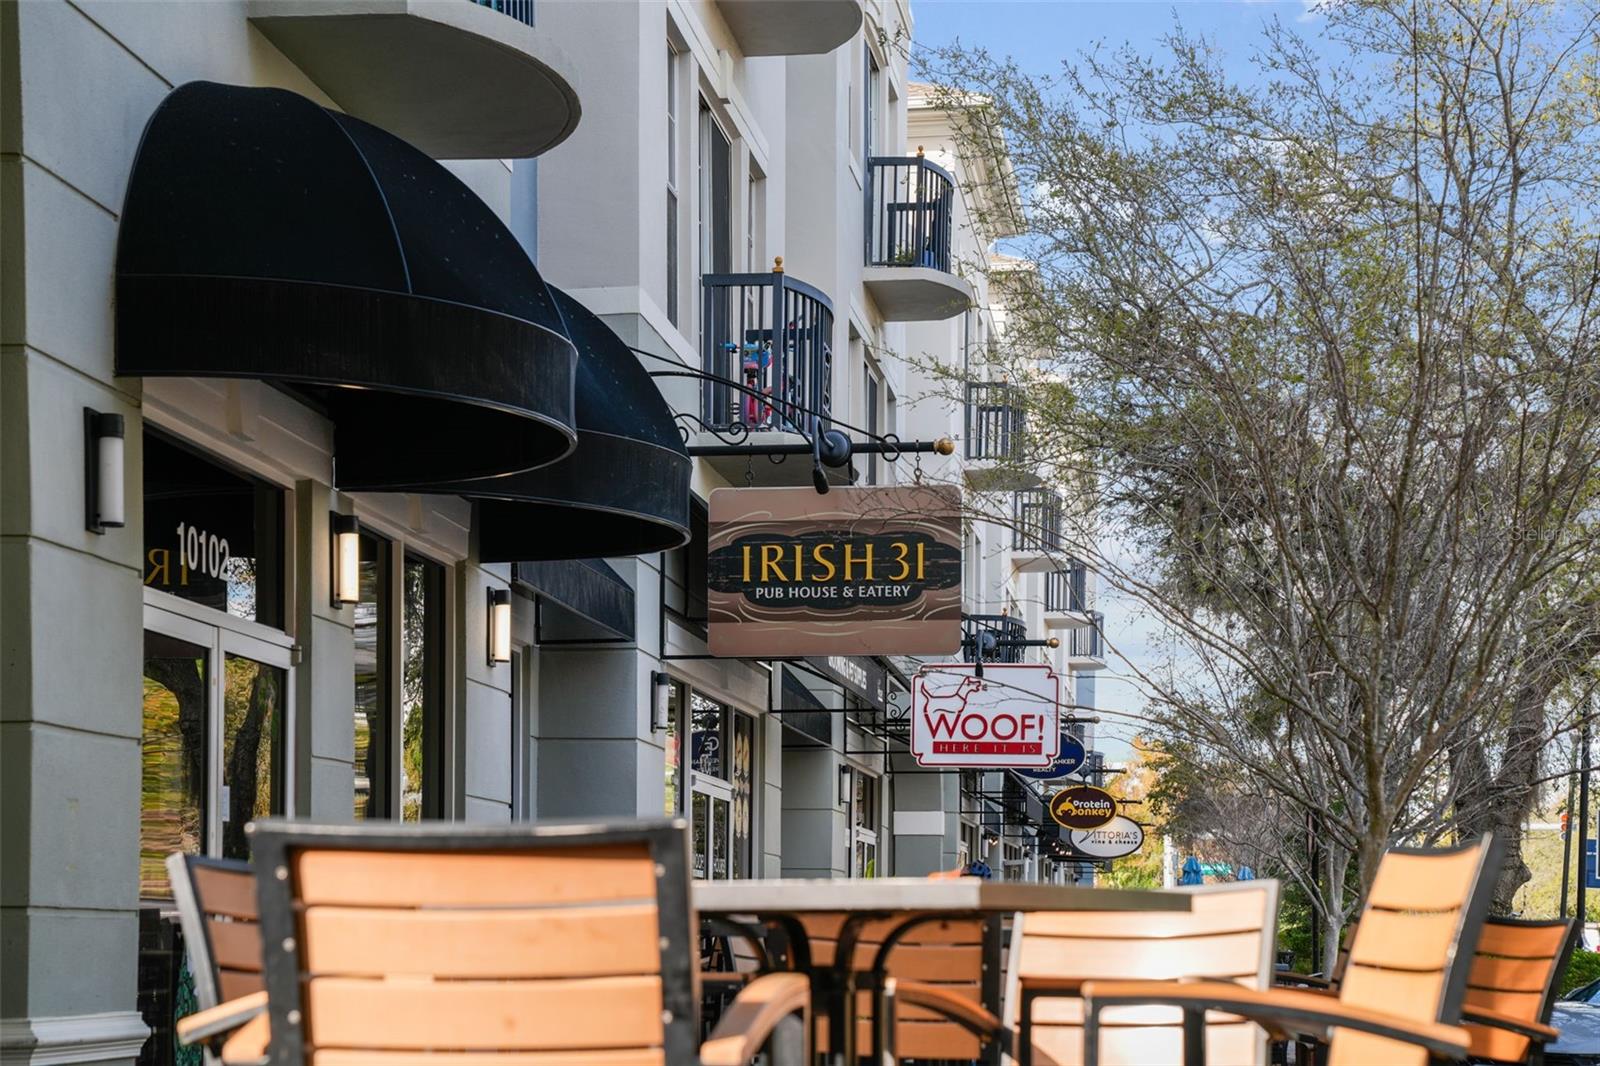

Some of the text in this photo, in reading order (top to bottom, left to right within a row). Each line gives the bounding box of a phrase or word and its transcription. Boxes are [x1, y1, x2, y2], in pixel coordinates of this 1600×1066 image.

[177, 522, 229, 581] 10102
[743, 542, 925, 582] IRISH 31
[755, 585, 911, 599] PUB HOUSE & EATERY
[924, 713, 1044, 741] WOOF!
[940, 744, 1036, 753] HERE IT IS
[1073, 799, 1110, 809] Protein
